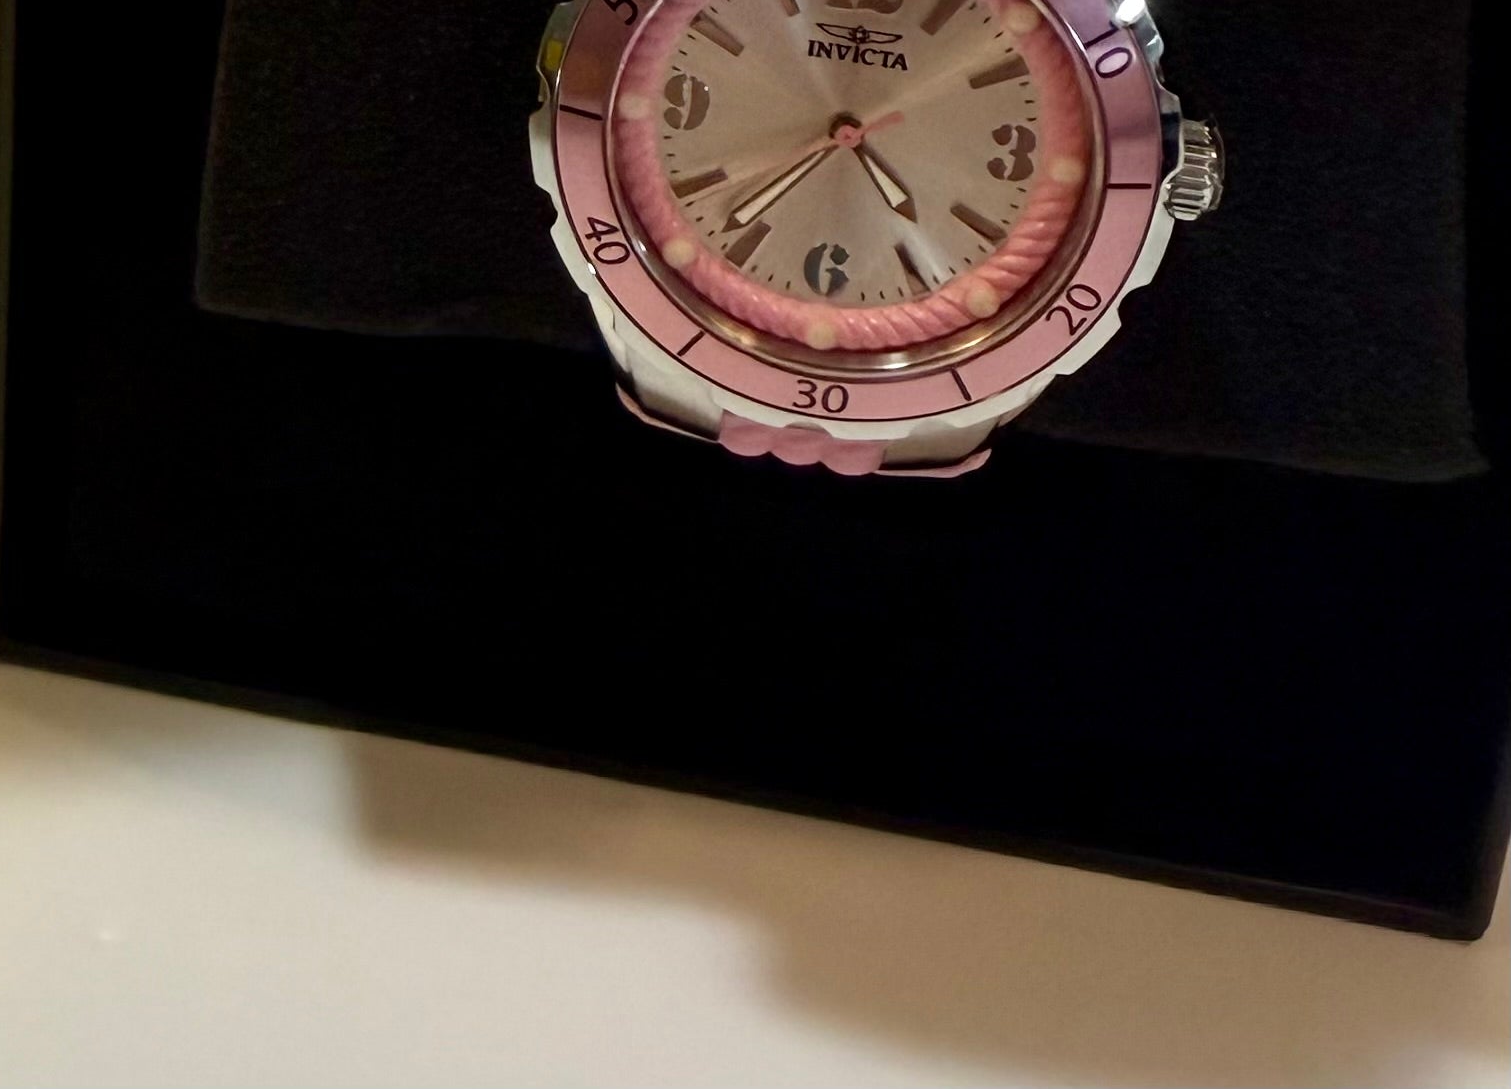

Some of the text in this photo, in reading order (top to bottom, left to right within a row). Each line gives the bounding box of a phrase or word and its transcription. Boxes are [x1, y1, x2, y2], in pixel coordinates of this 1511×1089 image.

[807, 39, 908, 71] INVICTA
[1083, 20, 1133, 79] 10
[663, 74, 710, 130] 9
[988, 123, 1037, 182] 3
[584, 215, 630, 265] 40
[804, 242, 850, 296] 6
[1046, 284, 1102, 337] 20
[791, 379, 849, 414] 30
